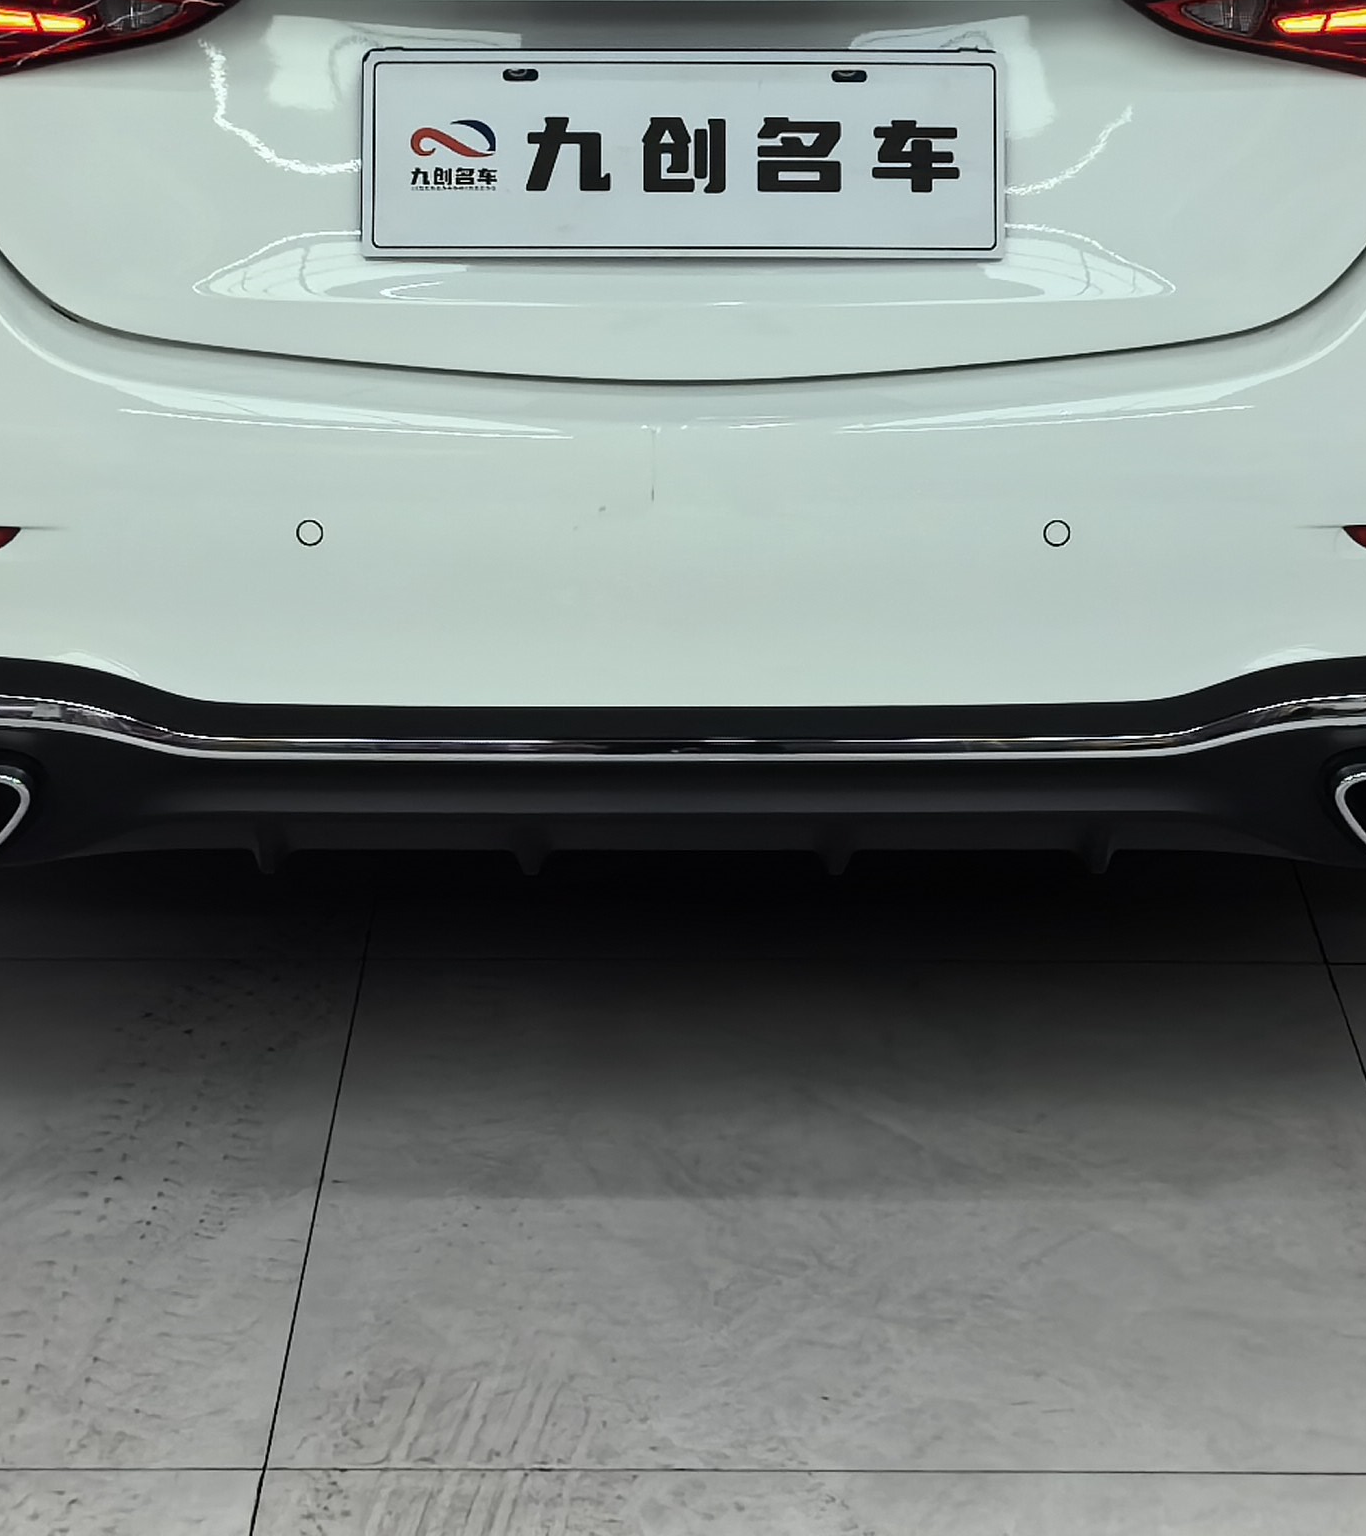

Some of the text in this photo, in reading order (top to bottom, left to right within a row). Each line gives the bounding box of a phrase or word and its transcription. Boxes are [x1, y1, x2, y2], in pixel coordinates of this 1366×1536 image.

[410, 166, 498, 186] 九创名车
[525, 116, 961, 194] 九创名车
